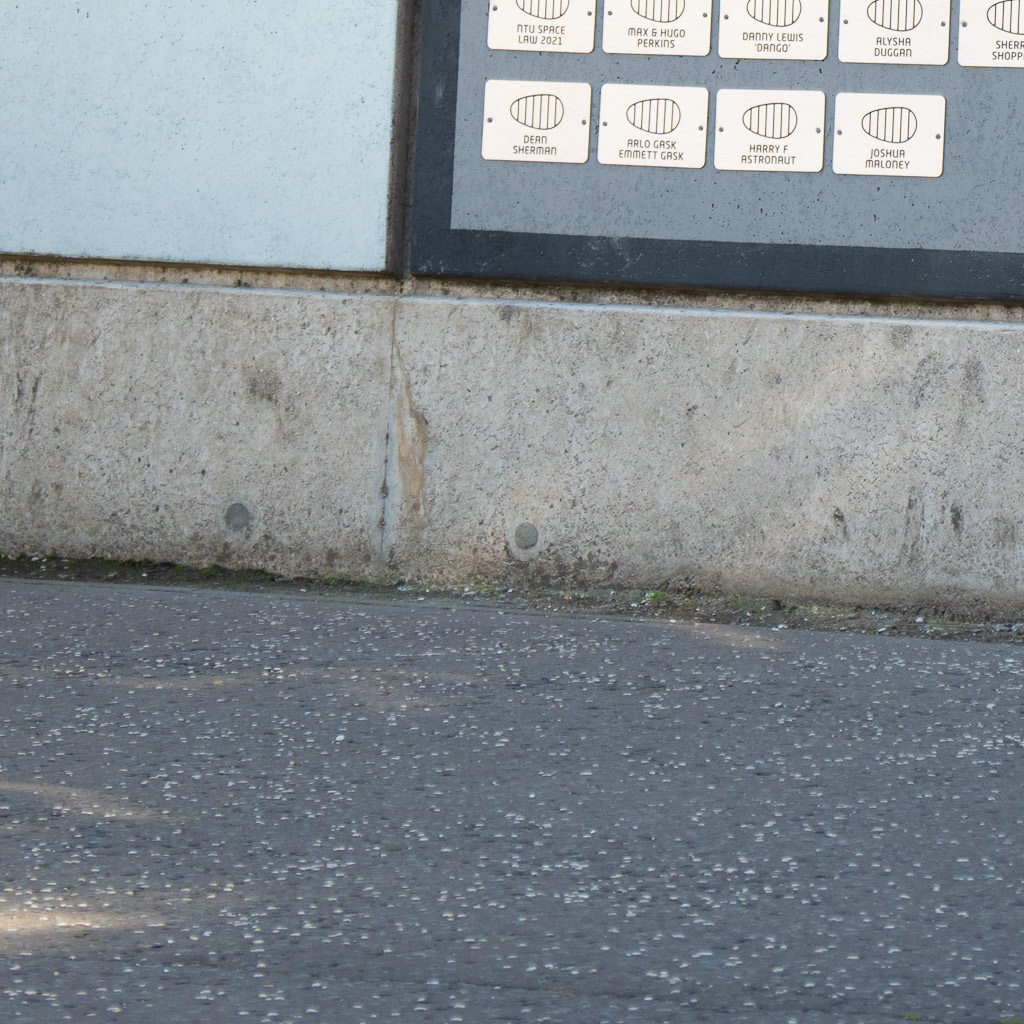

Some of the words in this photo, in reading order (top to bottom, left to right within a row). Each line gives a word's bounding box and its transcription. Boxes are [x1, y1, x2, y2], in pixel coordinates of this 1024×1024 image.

[516, 23, 536, 34] NTU
[537, 24, 566, 35] SPACE
[627, 27, 649, 37] MAX
[651, 27, 658, 38] &
[660, 28, 686, 38] HUGO
[518, 34, 538, 45] LAW
[540, 35, 563, 46] 2021
[742, 31, 774, 42] DANNY
[776, 32, 804, 43] LEWIS
[875, 36, 912, 47] ALYSHA
[637, 38, 676, 49] PERKINS
[874, 47, 913, 58] DUGGAN
[523, 134, 548, 145] DEAN
[626, 138, 651, 149] ARLO
[653, 139, 677, 150] GASK
[512, 145, 557, 156] SHERMAN
[749, 144, 781, 154] HARRY
[783, 144, 789, 154] F
[870, 148, 906, 160] JOSHUA
[618, 149, 658, 160] EMMETT
[660, 150, 684, 161] GASK
[740, 154, 796, 165] ASTRONAUT
[865, 159, 910, 170] MALONEY
